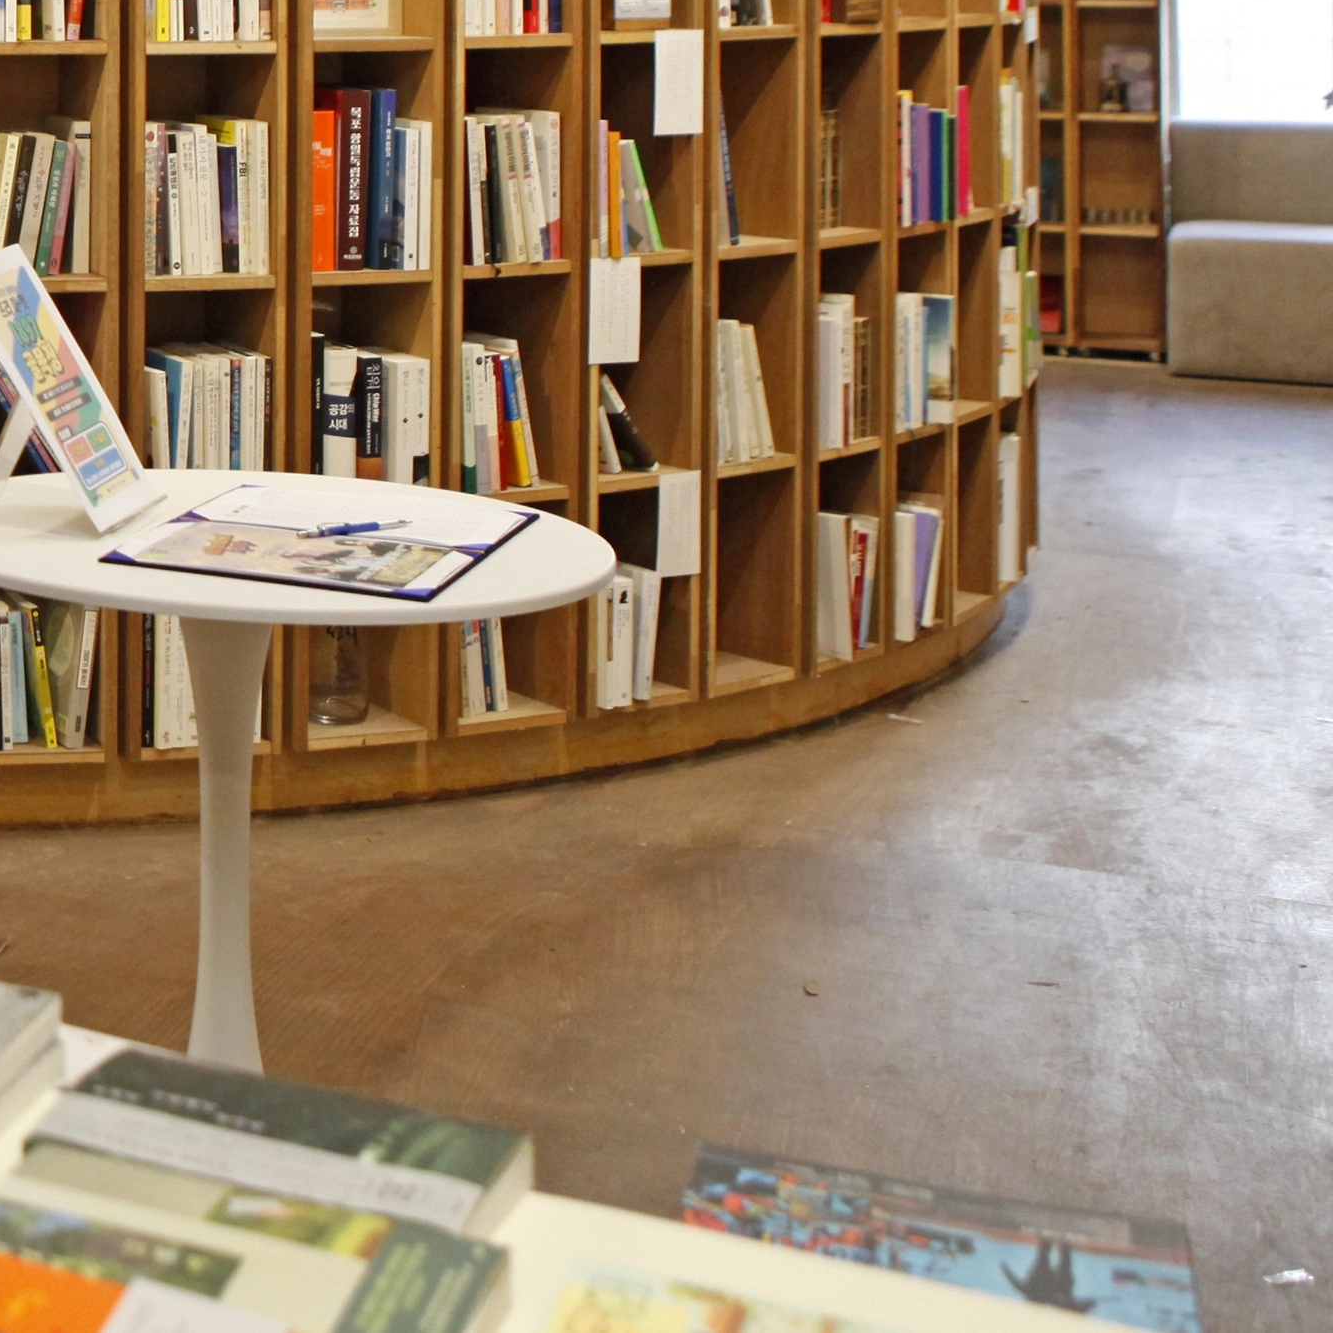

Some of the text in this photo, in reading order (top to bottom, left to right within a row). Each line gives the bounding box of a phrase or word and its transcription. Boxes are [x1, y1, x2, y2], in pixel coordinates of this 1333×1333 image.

[238, 161, 247, 178] FBI
[348, 106, 363, 238] 목포 항일독립운동 자료집
[366, 363, 381, 390] 칩워
[373, 392, 381, 407] Chip
